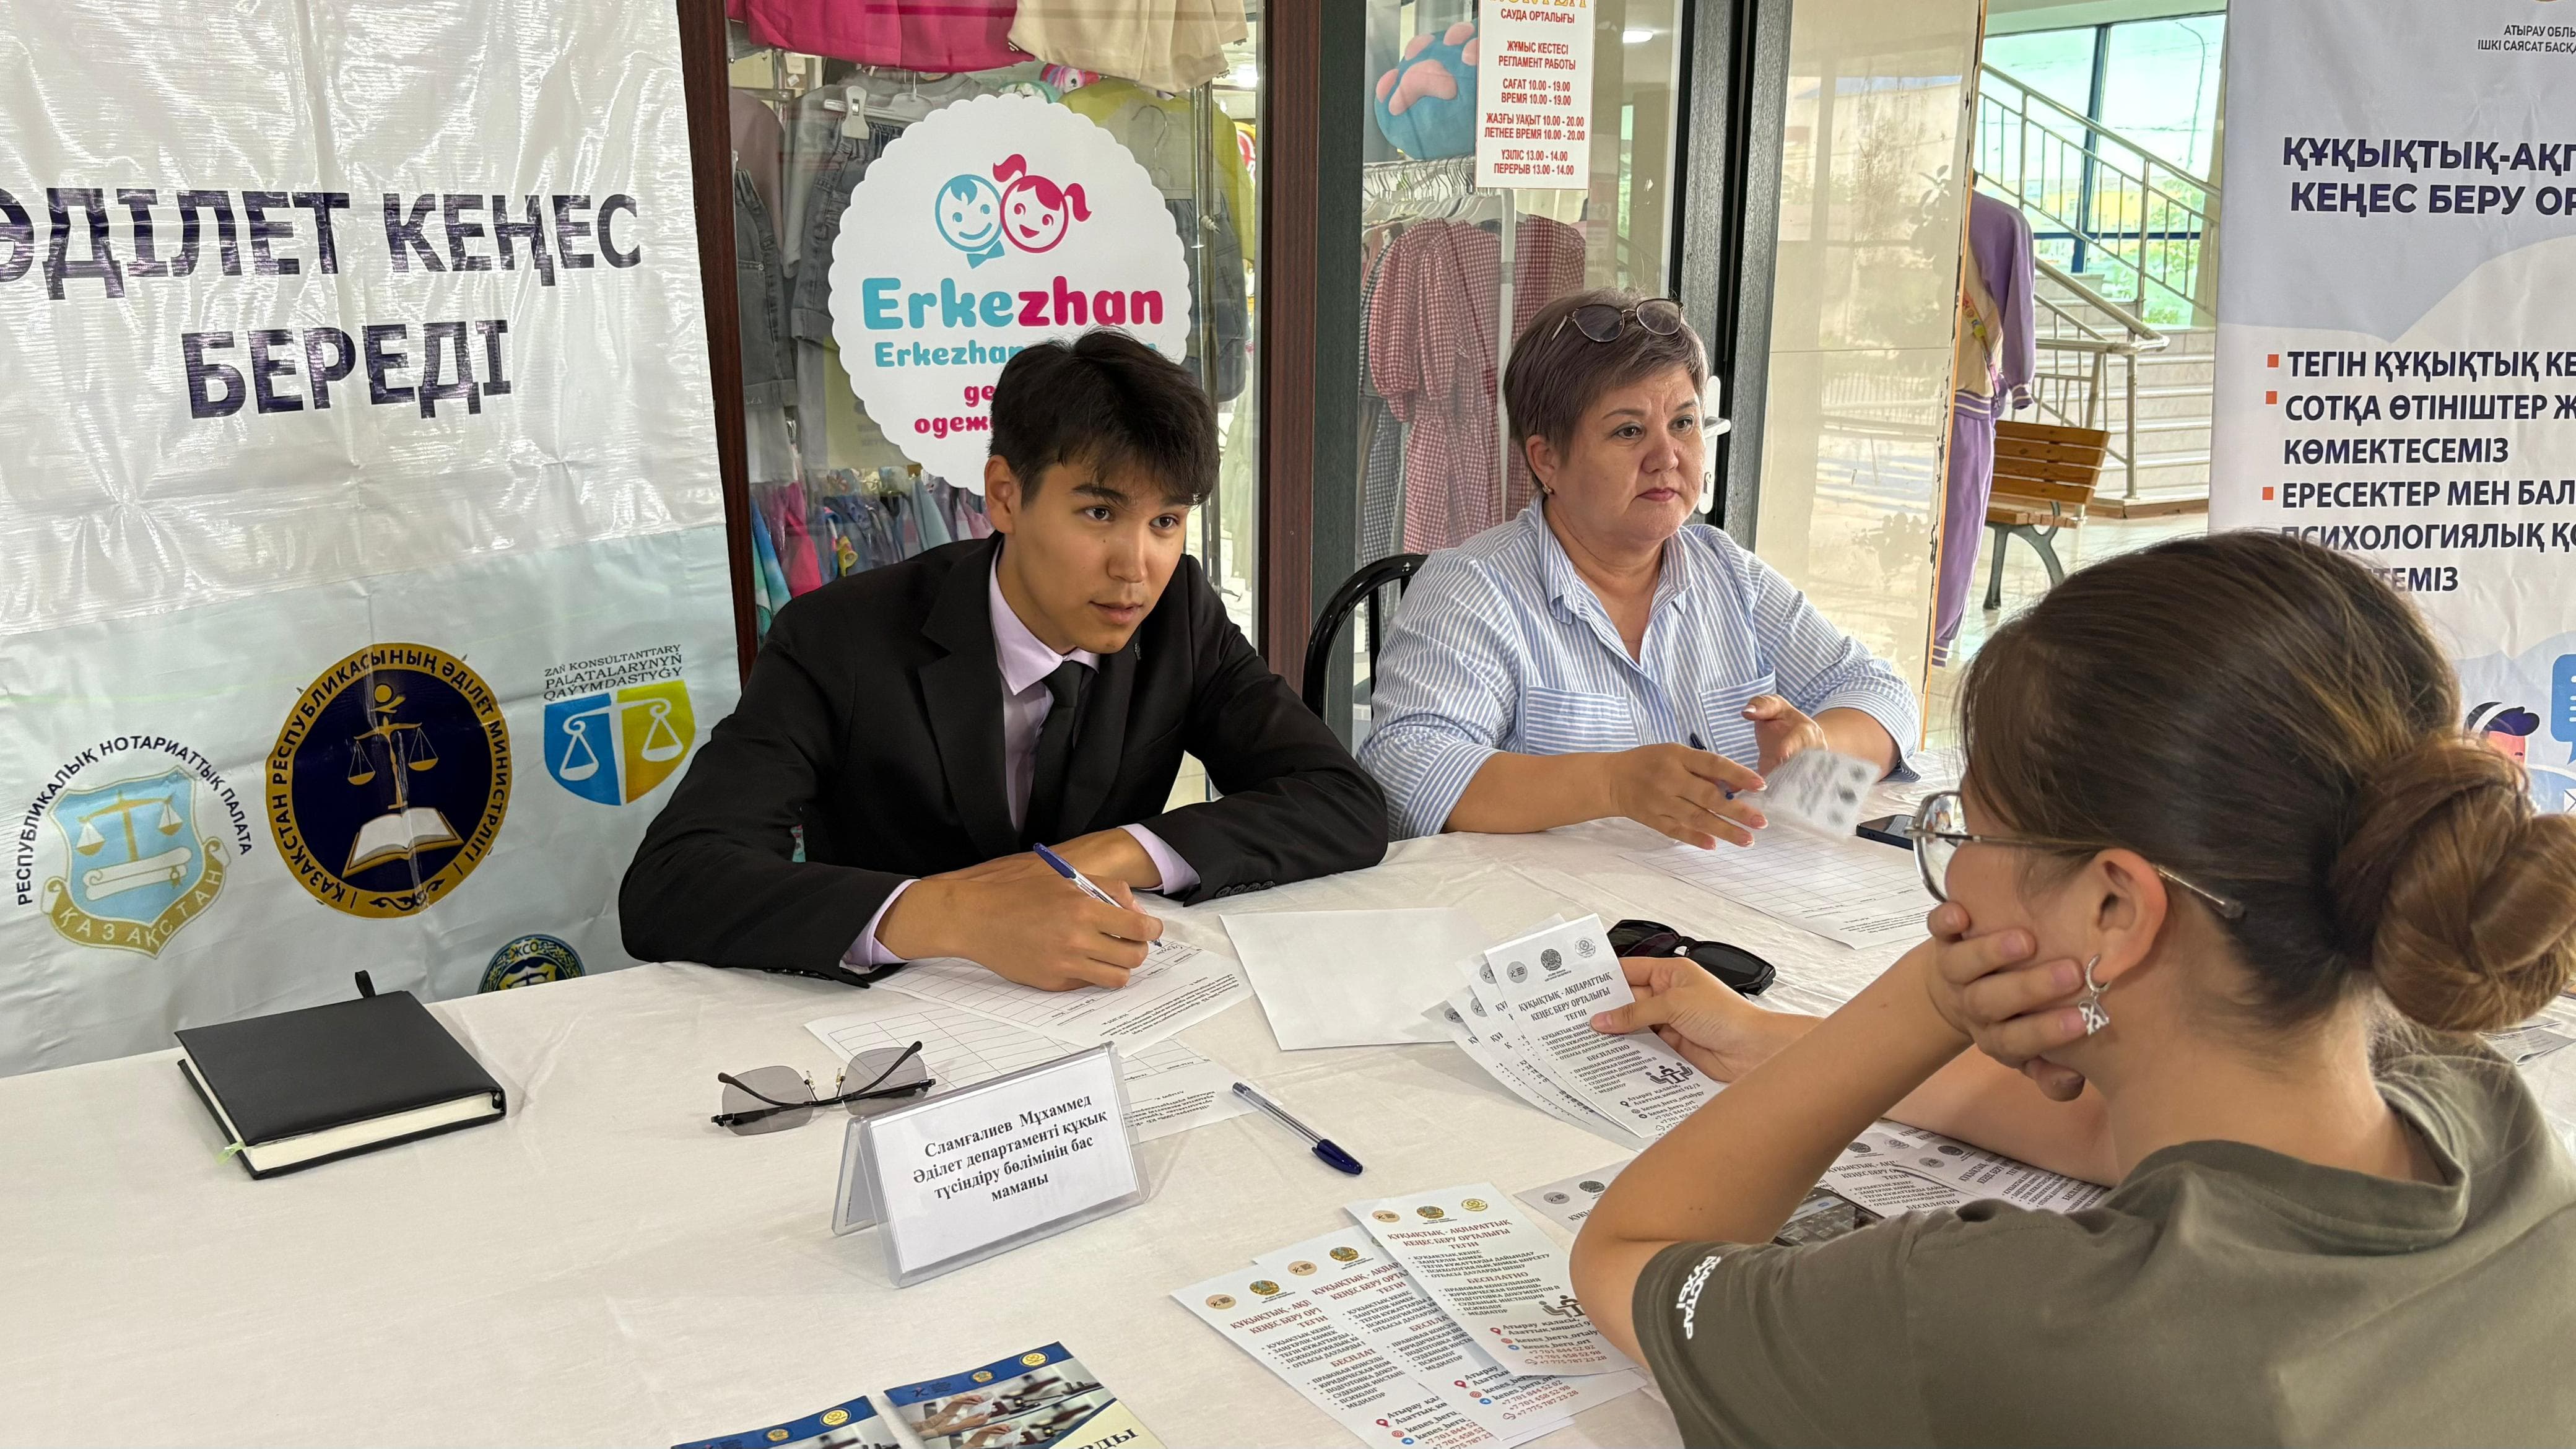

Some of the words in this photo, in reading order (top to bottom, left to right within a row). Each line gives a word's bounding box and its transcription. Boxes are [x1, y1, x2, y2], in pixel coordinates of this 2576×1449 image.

[1501, 9, 1527, 21] САУДА
[1530, 11, 1574, 24] ОРТАЛЫҒЫ
[2504, 25, 2546, 37] АТЫРАУ
[1507, 41, 1536, 52] ЖҰМЫС
[1538, 43, 1568, 54] КЕСТЕСІ
[2478, 40, 2501, 50] ІШКІ
[2504, 40, 2544, 51] САЯСАТ
[1499, 56, 1543, 68] РЕГЛАМЕНТ
[1544, 58, 1575, 69] РАБОТЫ
[1503, 79, 1526, 89] САҒАТ
[1529, 80, 1546, 90] 10.00
[1553, 81, 1570, 92] 19.00
[1501, 93, 1527, 104] ВРЕМЯ
[1530, 94, 1547, 104] 10.00
[1554, 95, 1571, 105] 19.00
[1487, 113, 1513, 124] ЖАЗҒЫ
[1516, 114, 1541, 126] УАҚЫТ
[1543, 115, 1560, 125] 10.00
[1567, 116, 1584, 126] 20.00
[1485, 128, 1513, 138] ЛЕТНЕЕ
[1516, 128, 1541, 139] ВРЕМЯ
[1544, 130, 1560, 139] 10.00
[1567, 130, 1585, 140] 20.00
[1501, 149, 1524, 160] ҮЗІЛІС
[1526, 150, 1544, 160] 13.00
[1551, 151, 1568, 161] 14.00
[1494, 163, 1530, 174] ПЕРЕРЫВ
[1533, 165, 1550, 175] 13.00
[1557, 165, 1574, 175] 14.00
[2291, 182, 2417, 217] КЕҢЕС
[2429, 185, 2525, 215] БЕРУ
[383, 193, 642, 286] КЕҢЕС
[862, 276, 1164, 330] Erkezhan
[182, 319, 511, 419] БЕРЕДІ
[2287, 352, 2365, 377] ТЕГІН
[2375, 352, 2539, 383] ҚҰҚЫҚТЫҚ
[2286, 395, 2381, 426] СОТҚА
[2390, 395, 2548, 420] ӨТІНІШТЕР
[2284, 438, 2509, 464] КӨМЕКТЕСЕМІЗ
[2282, 481, 2440, 508] ЕРЕСЕКТЕР
[2447, 481, 2509, 506] МЕН
[441, 661, 494, 717] ӘДІЛЕТ
[273, 650, 437, 786] РЕСПУБЛИКАСЫНЫҢ
[463, 719, 508, 865] МИНИСТРЛІГІ
[17, 749, 99, 905] РЕСПУБЛИКАЛЫҚ
[99, 736, 222, 791] НОТАРИАТТЫҚ
[221, 787, 252, 855] ПАЛАТА
[272, 793, 346, 903] ҚАЗАҚСТАН
[58, 868, 223, 946] ҚАЗАҚСТАН
[1531, 1007, 1554, 1021] КЕҢЕС
[1554, 1001, 1569, 1013] БЕРУ
[1571, 987, 1610, 1007] ОРТАЛЫҒЫ
[1564, 1009, 1587, 1021] ТЕГІН
[925, 1121, 1013, 1158] Сламғалиев
[1019, 1095, 1092, 1129] Мұхаммед
[913, 1159, 962, 1184] Әділет
[967, 1124, 1059, 1167] департаменті
[1063, 1110, 1108, 1135] құқық
[934, 1167, 999, 1201] түсіндіру
[1004, 1146, 1069, 1175] бөлімінің
[1071, 1136, 1094, 1152] бас
[991, 1173, 1049, 1202] маманы
[1448, 1242, 1479, 1250] ТЕГІН
[1362, 1278, 1382, 1290] БЕРУ
[1376, 1281, 1406, 1294] ТЕГІН
[1466, 1272, 1529, 1284] БЕСПЛАТНО
[1282, 1312, 1302, 1325] БЕРУ
[1297, 1316, 1329, 1328] ТЕГІН
[1465, 1365, 1498, 1380] Атырау
